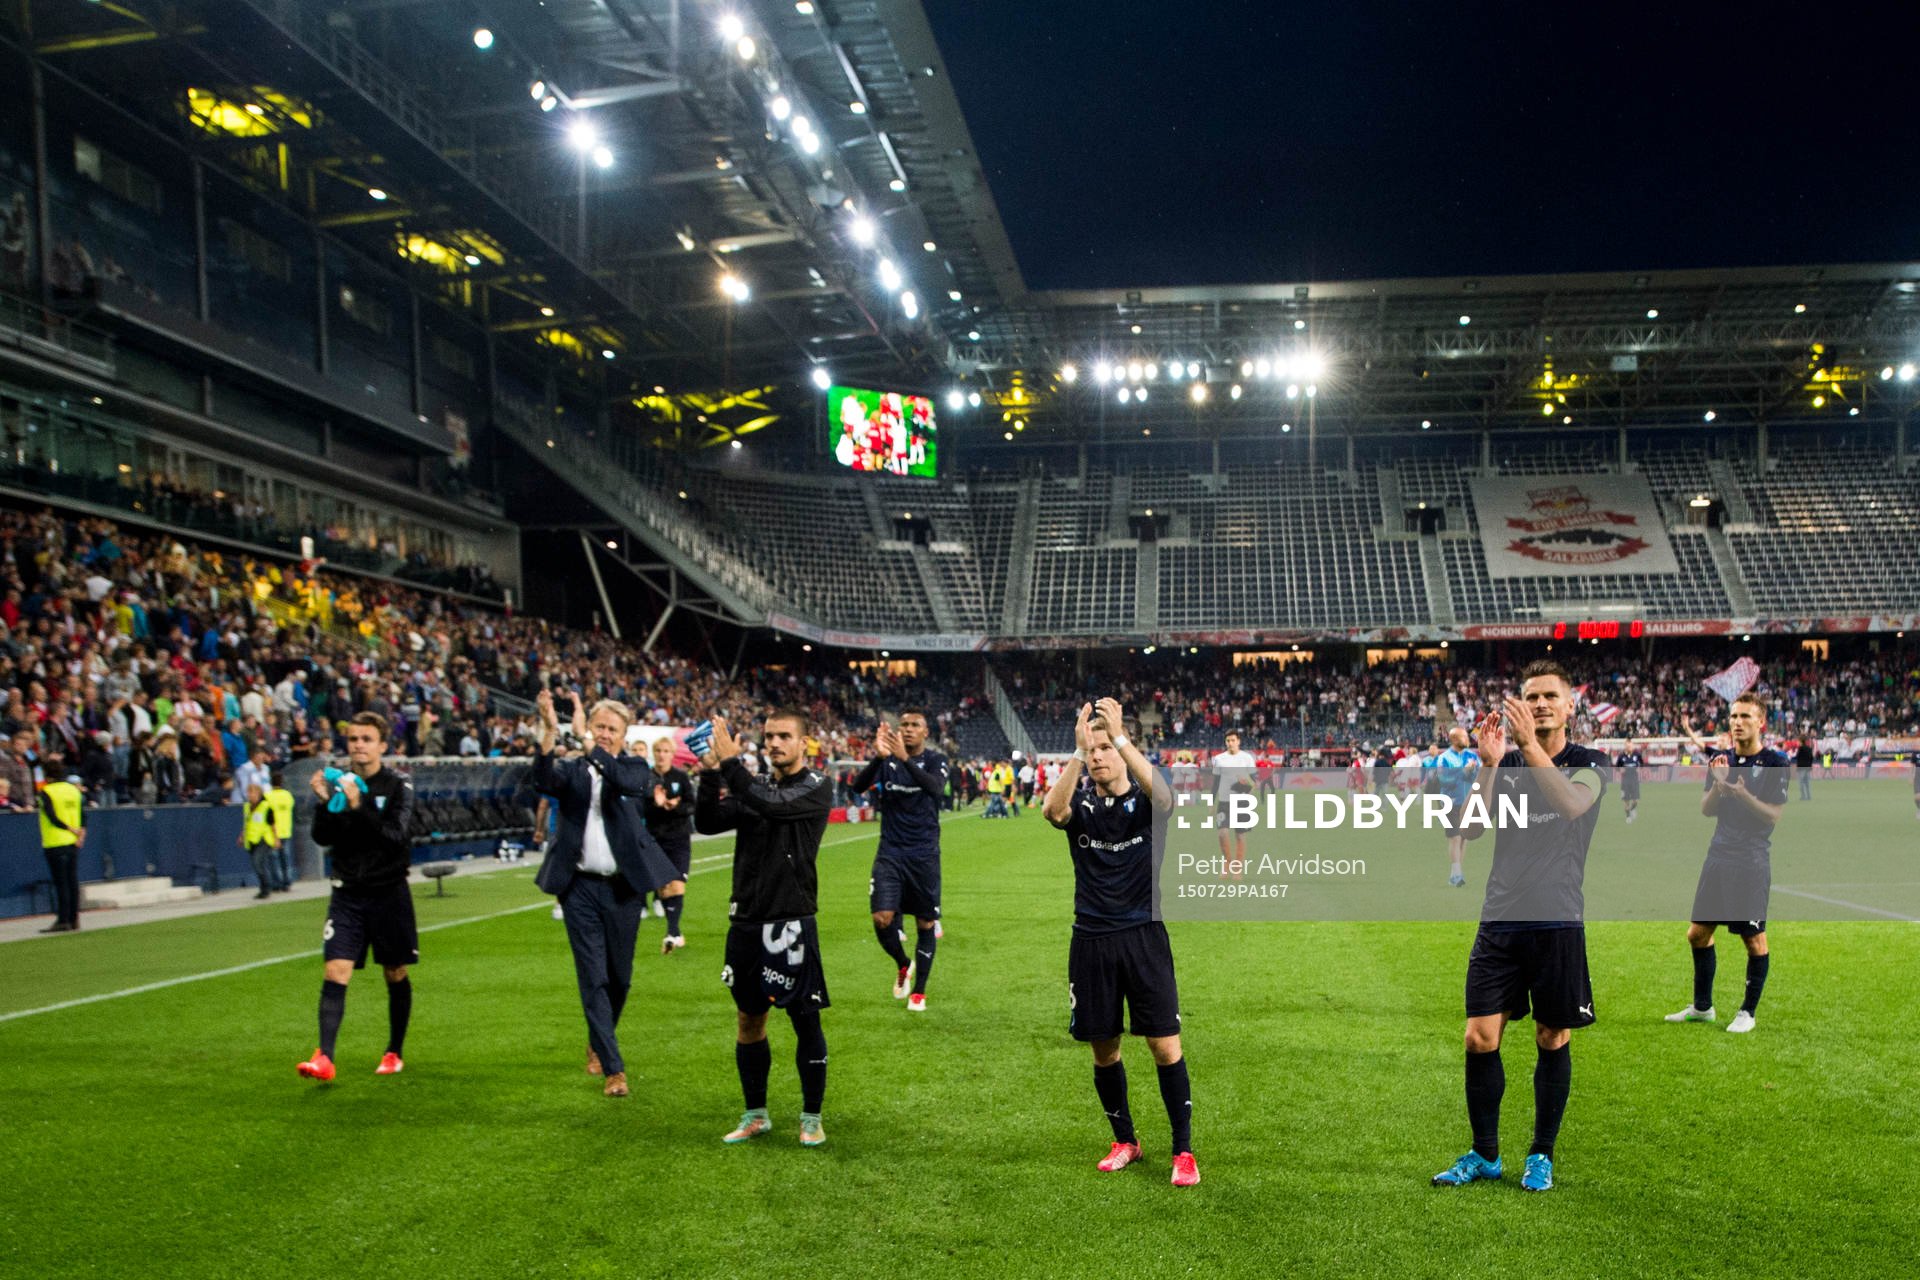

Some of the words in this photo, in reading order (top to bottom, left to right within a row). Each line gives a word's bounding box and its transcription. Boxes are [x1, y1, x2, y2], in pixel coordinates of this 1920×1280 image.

[1543, 548, 1620, 564] SALZBURG
[1481, 625, 1550, 638] NORDKURVE
[1630, 618, 1643, 638] 0
